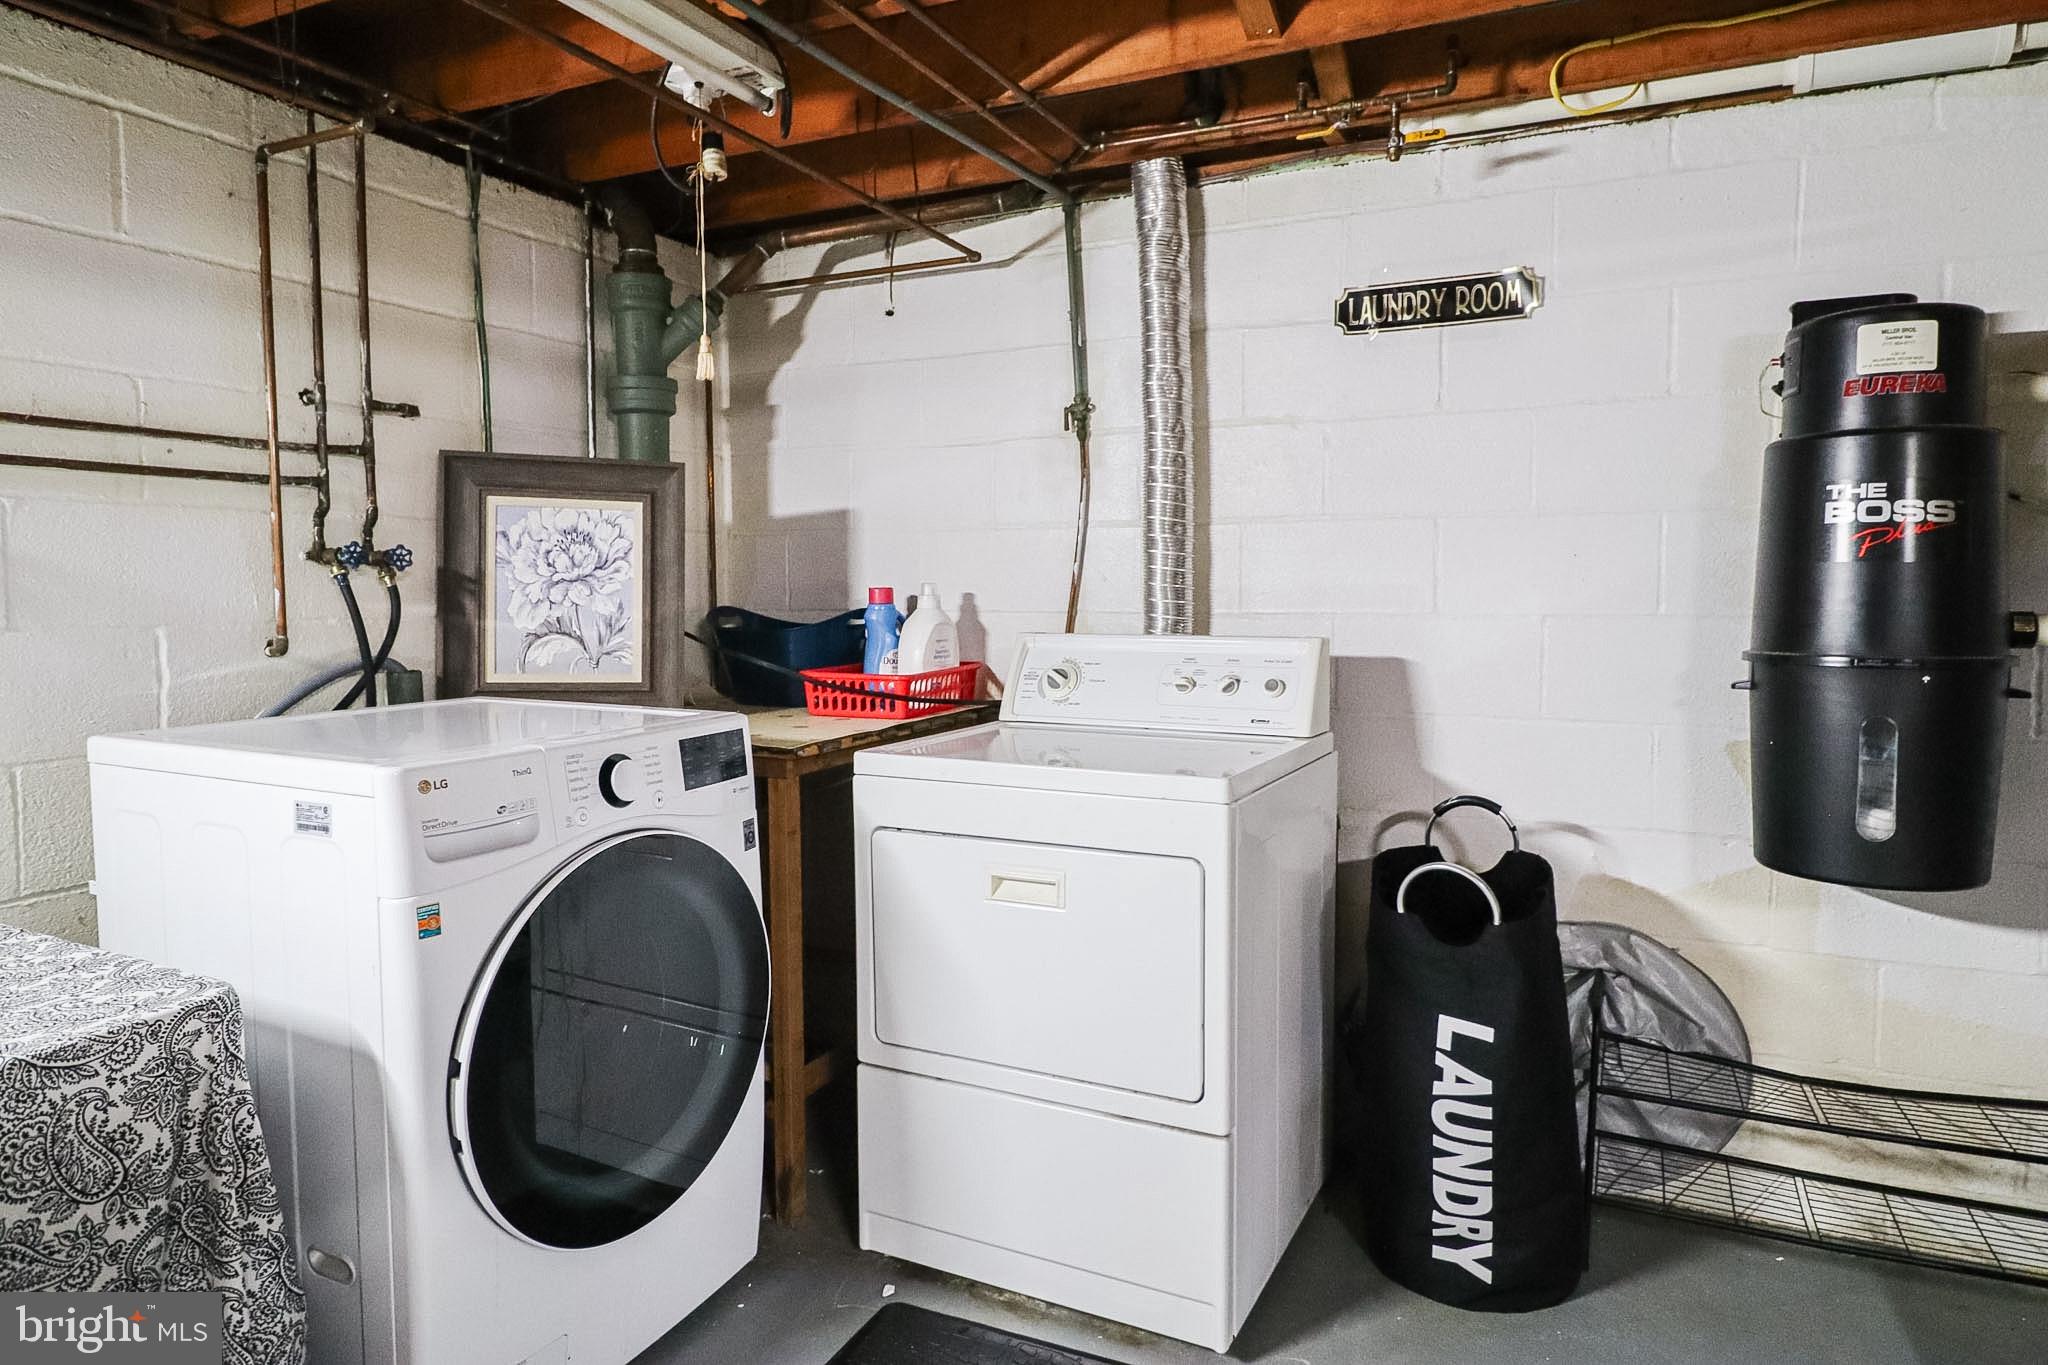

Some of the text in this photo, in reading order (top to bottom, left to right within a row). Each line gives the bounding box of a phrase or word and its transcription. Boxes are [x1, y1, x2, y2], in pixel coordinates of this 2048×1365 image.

[1348, 278, 1523, 326] LAUNDRY ROOM
[1842, 374, 1948, 399] EUREKA
[1825, 482, 1888, 500] THE
[1824, 499, 1956, 525] BOSS
[1849, 518, 1952, 558] Plus
[512, 766, 532, 777] ThinQ
[434, 779, 448, 792] LG
[1431, 1014, 1495, 1285] LAUNDRY
